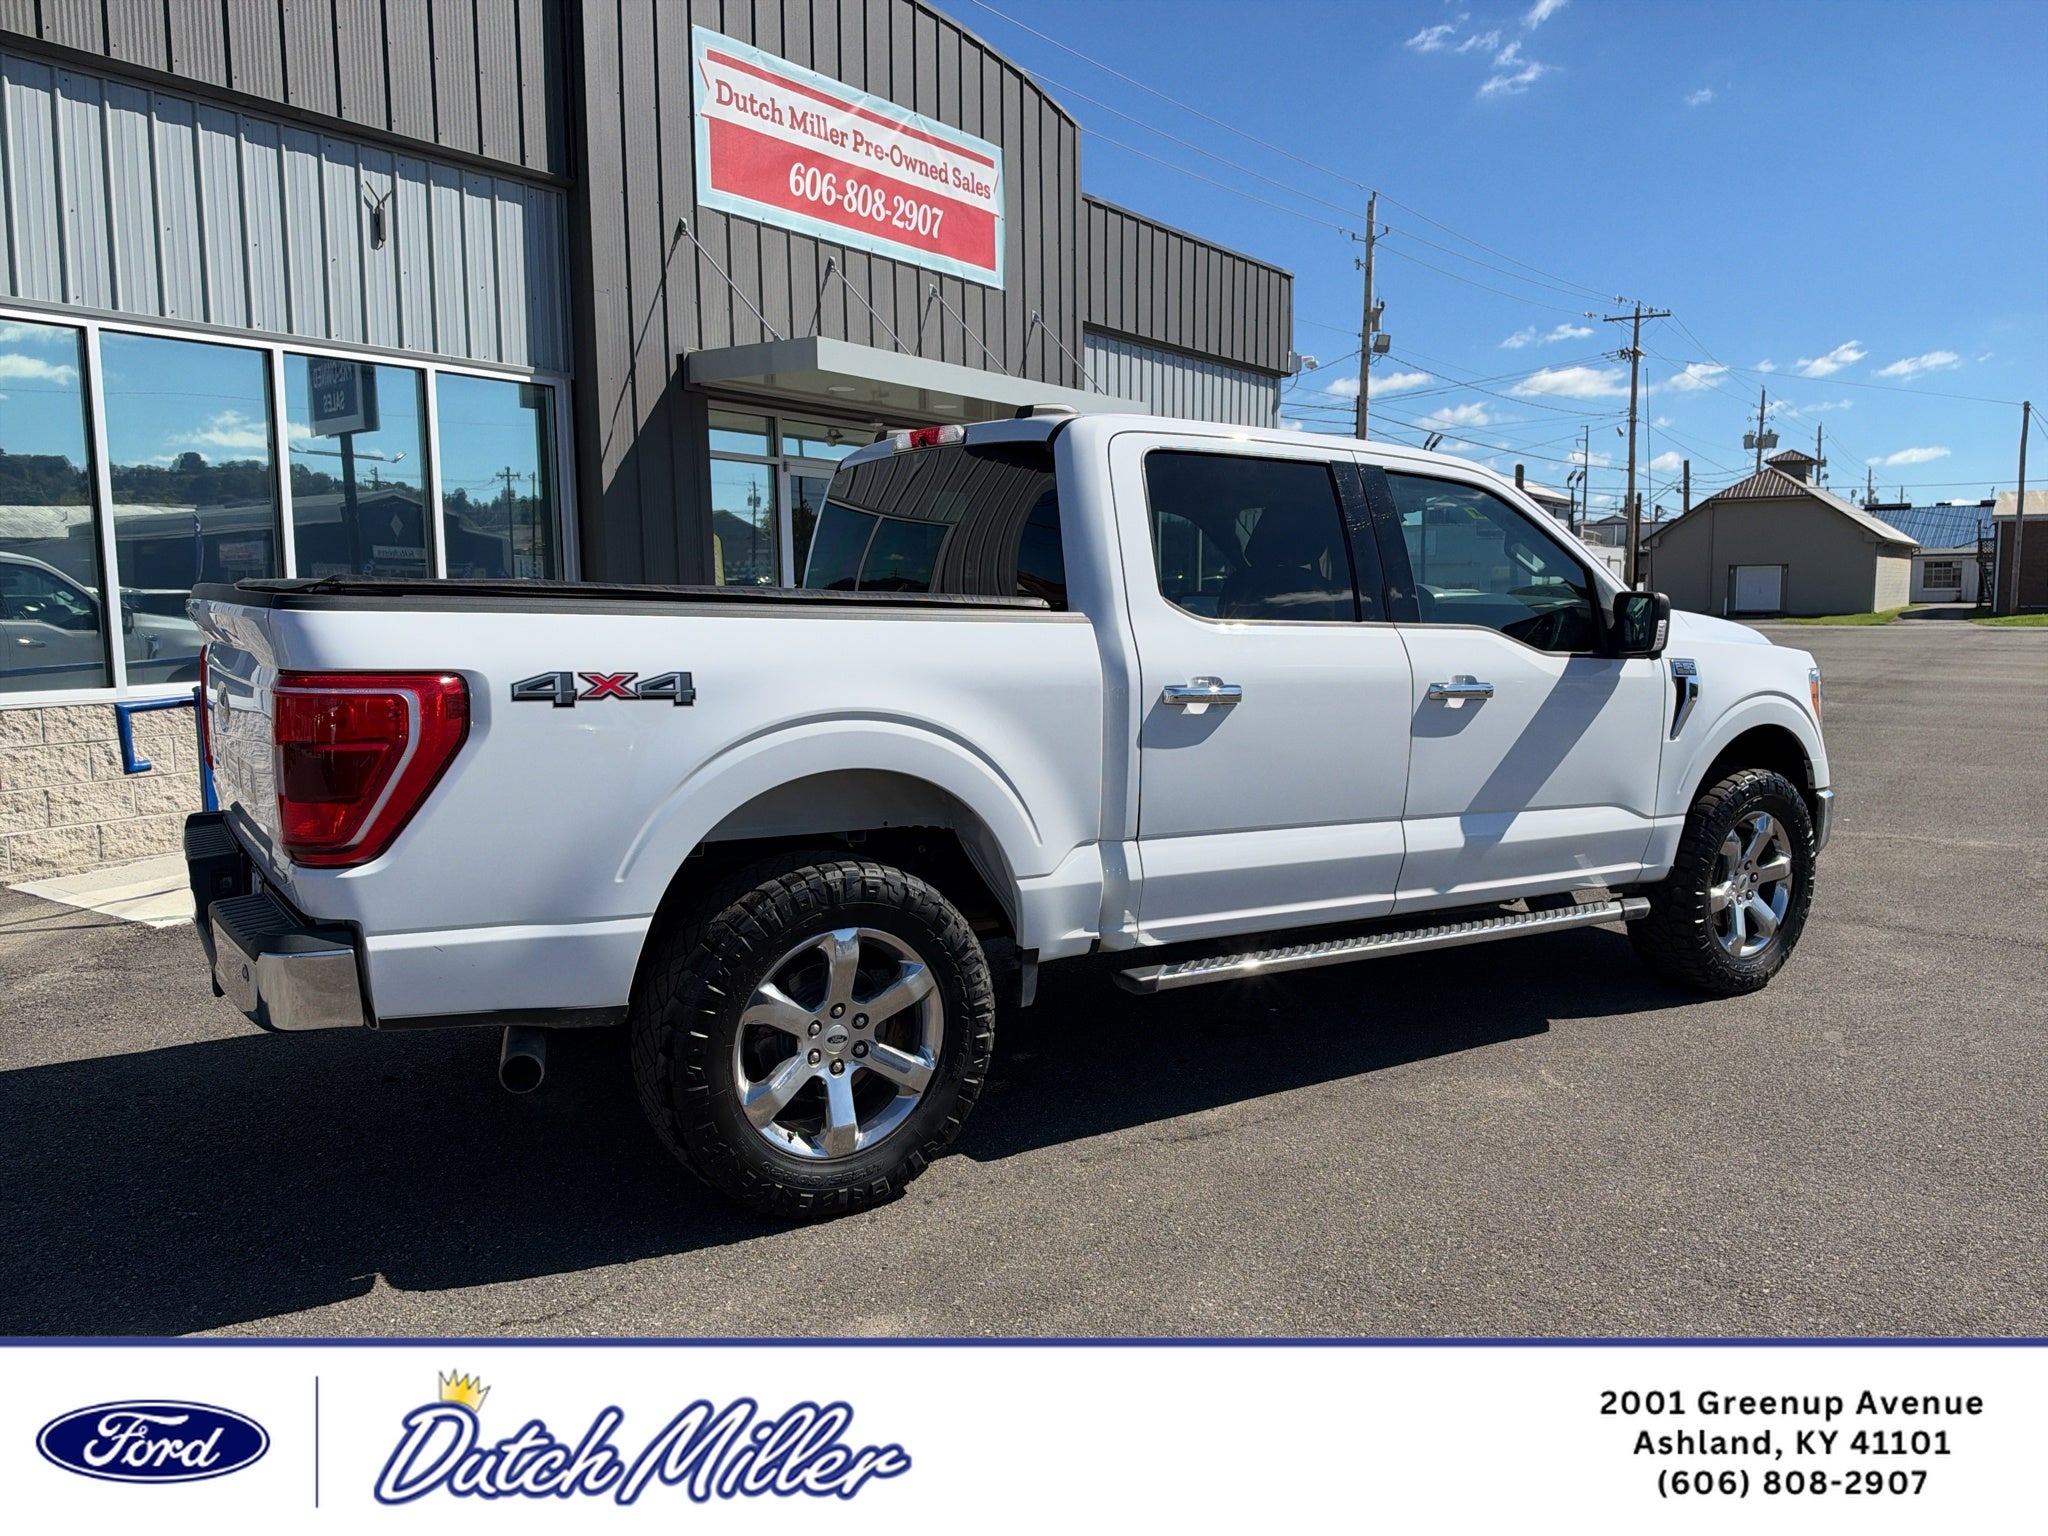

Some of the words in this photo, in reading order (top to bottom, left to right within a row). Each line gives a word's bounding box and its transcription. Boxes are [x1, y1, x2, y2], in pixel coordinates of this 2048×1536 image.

[715, 79, 783, 123] Dutch
[788, 106, 849, 147] Miller
[852, 129, 950, 185] Pre-Owned
[953, 167, 991, 200] Sales
[790, 162, 944, 239] 606-808-2907
